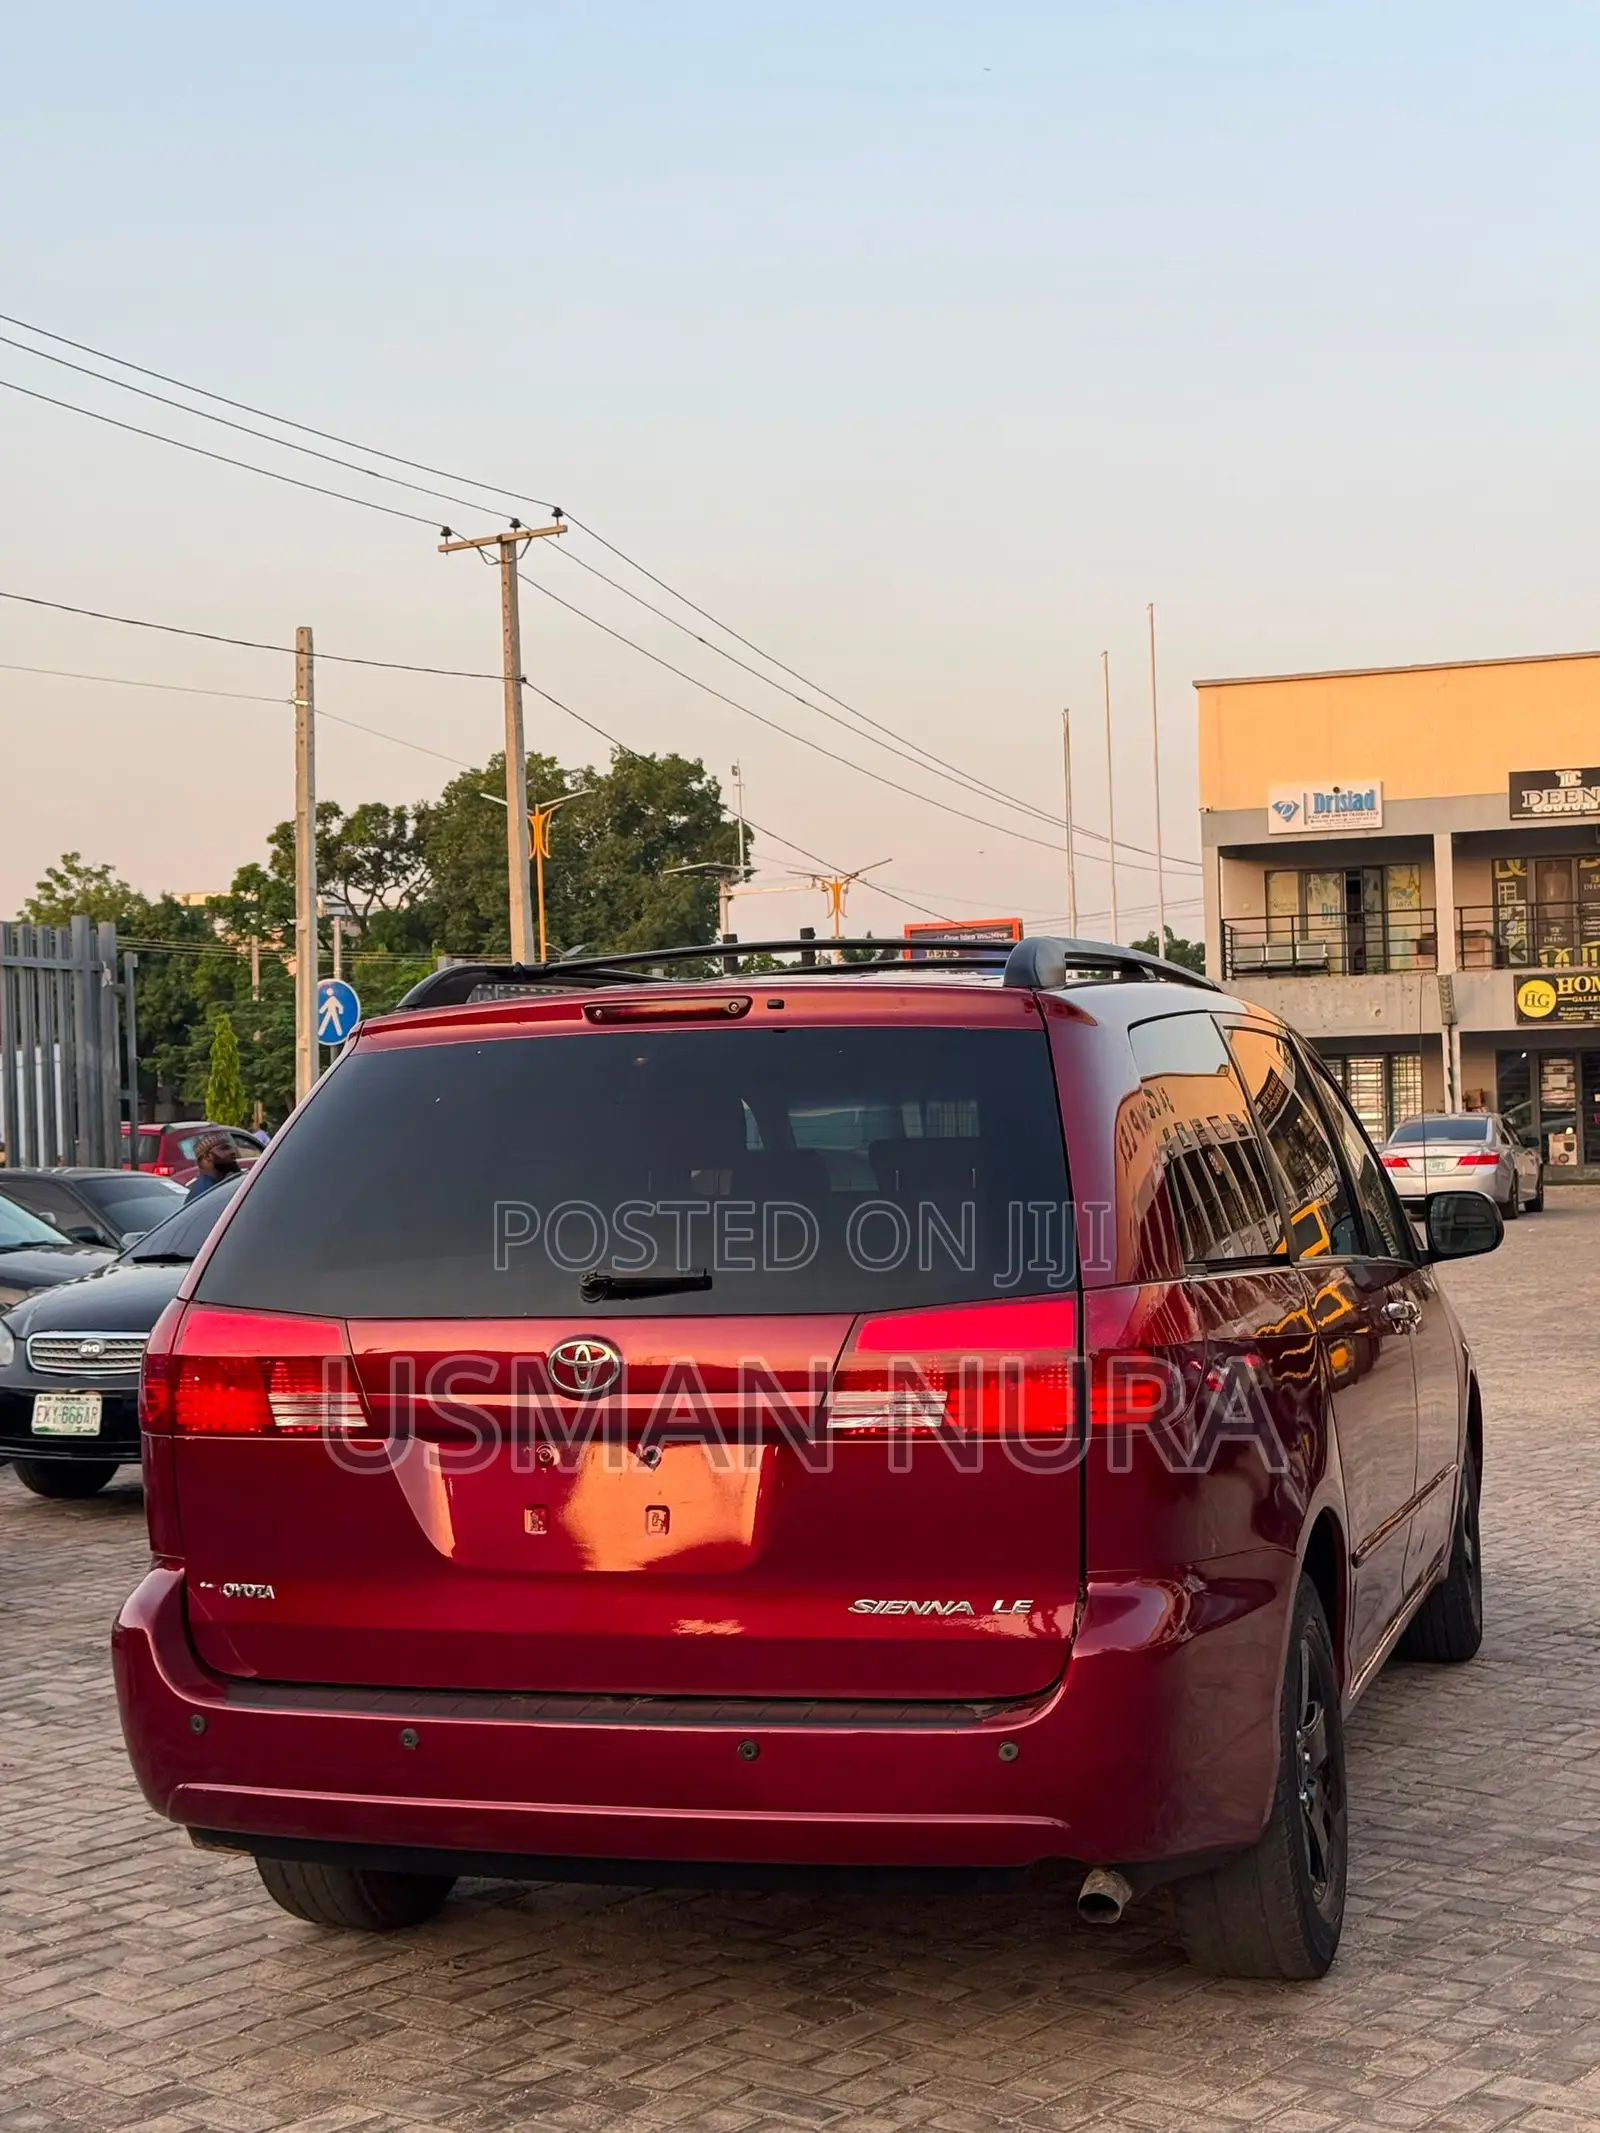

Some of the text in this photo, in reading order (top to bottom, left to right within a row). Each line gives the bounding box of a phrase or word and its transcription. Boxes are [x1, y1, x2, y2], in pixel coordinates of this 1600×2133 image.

[1572, 995, 1600, 1003] GALLE
[848, 1599, 1034, 1616] SIENNA LE
